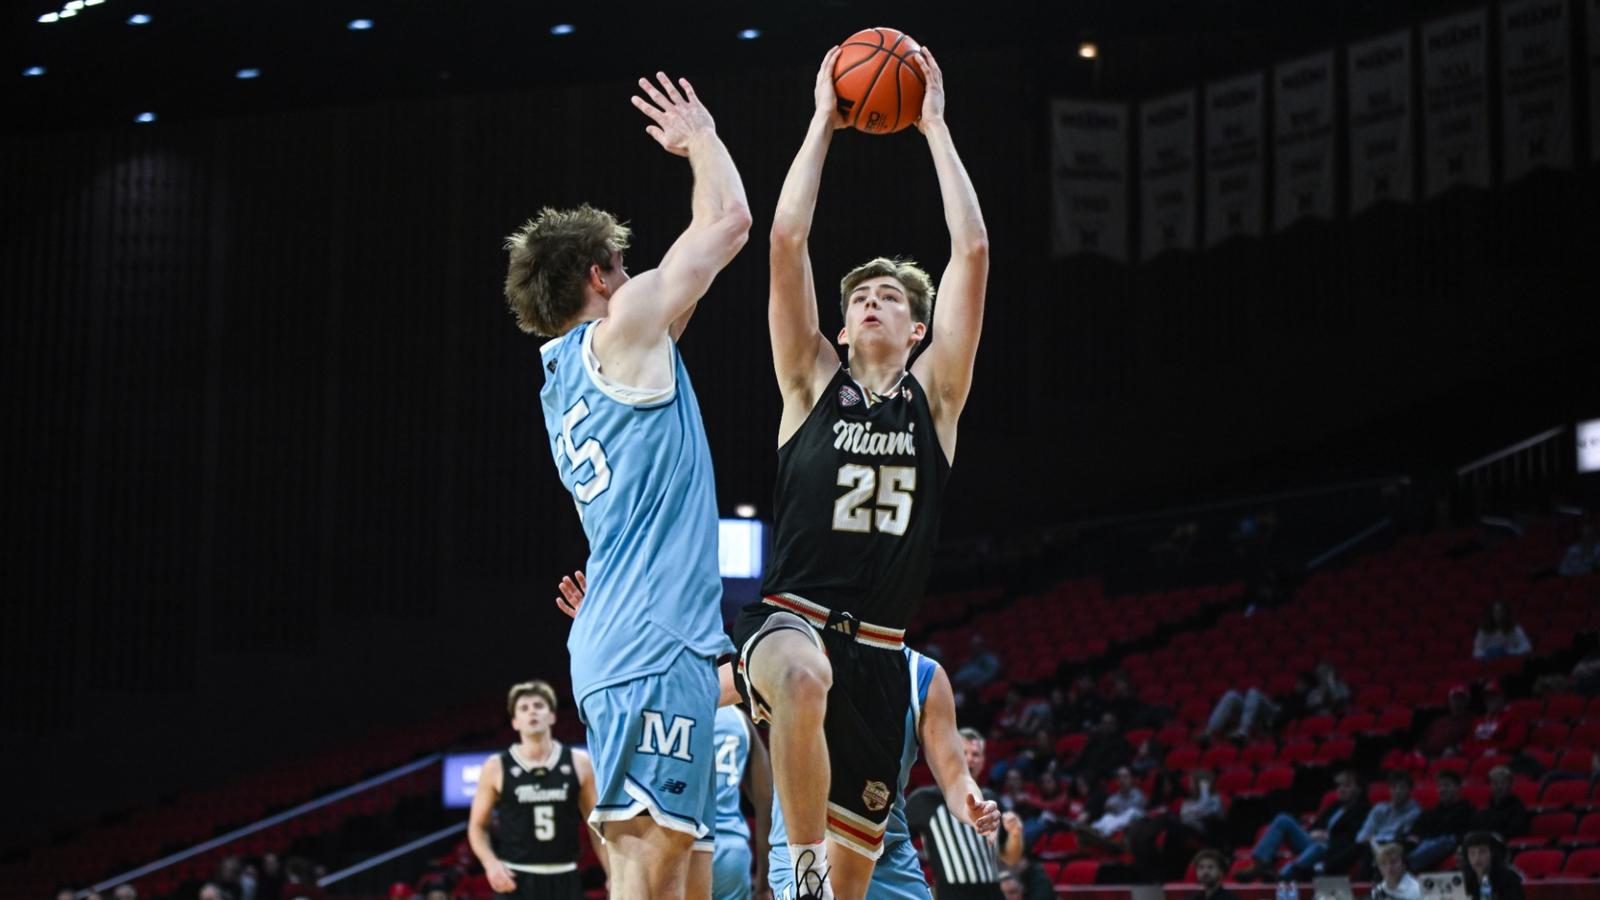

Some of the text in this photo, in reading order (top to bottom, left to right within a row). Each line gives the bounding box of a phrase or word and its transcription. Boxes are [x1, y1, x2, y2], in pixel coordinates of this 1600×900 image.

[833, 419, 915, 456] Miami
[832, 463, 916, 536] 25
[635, 708, 696, 763] M
[514, 783, 569, 803] Miami
[533, 805, 555, 841] 5
